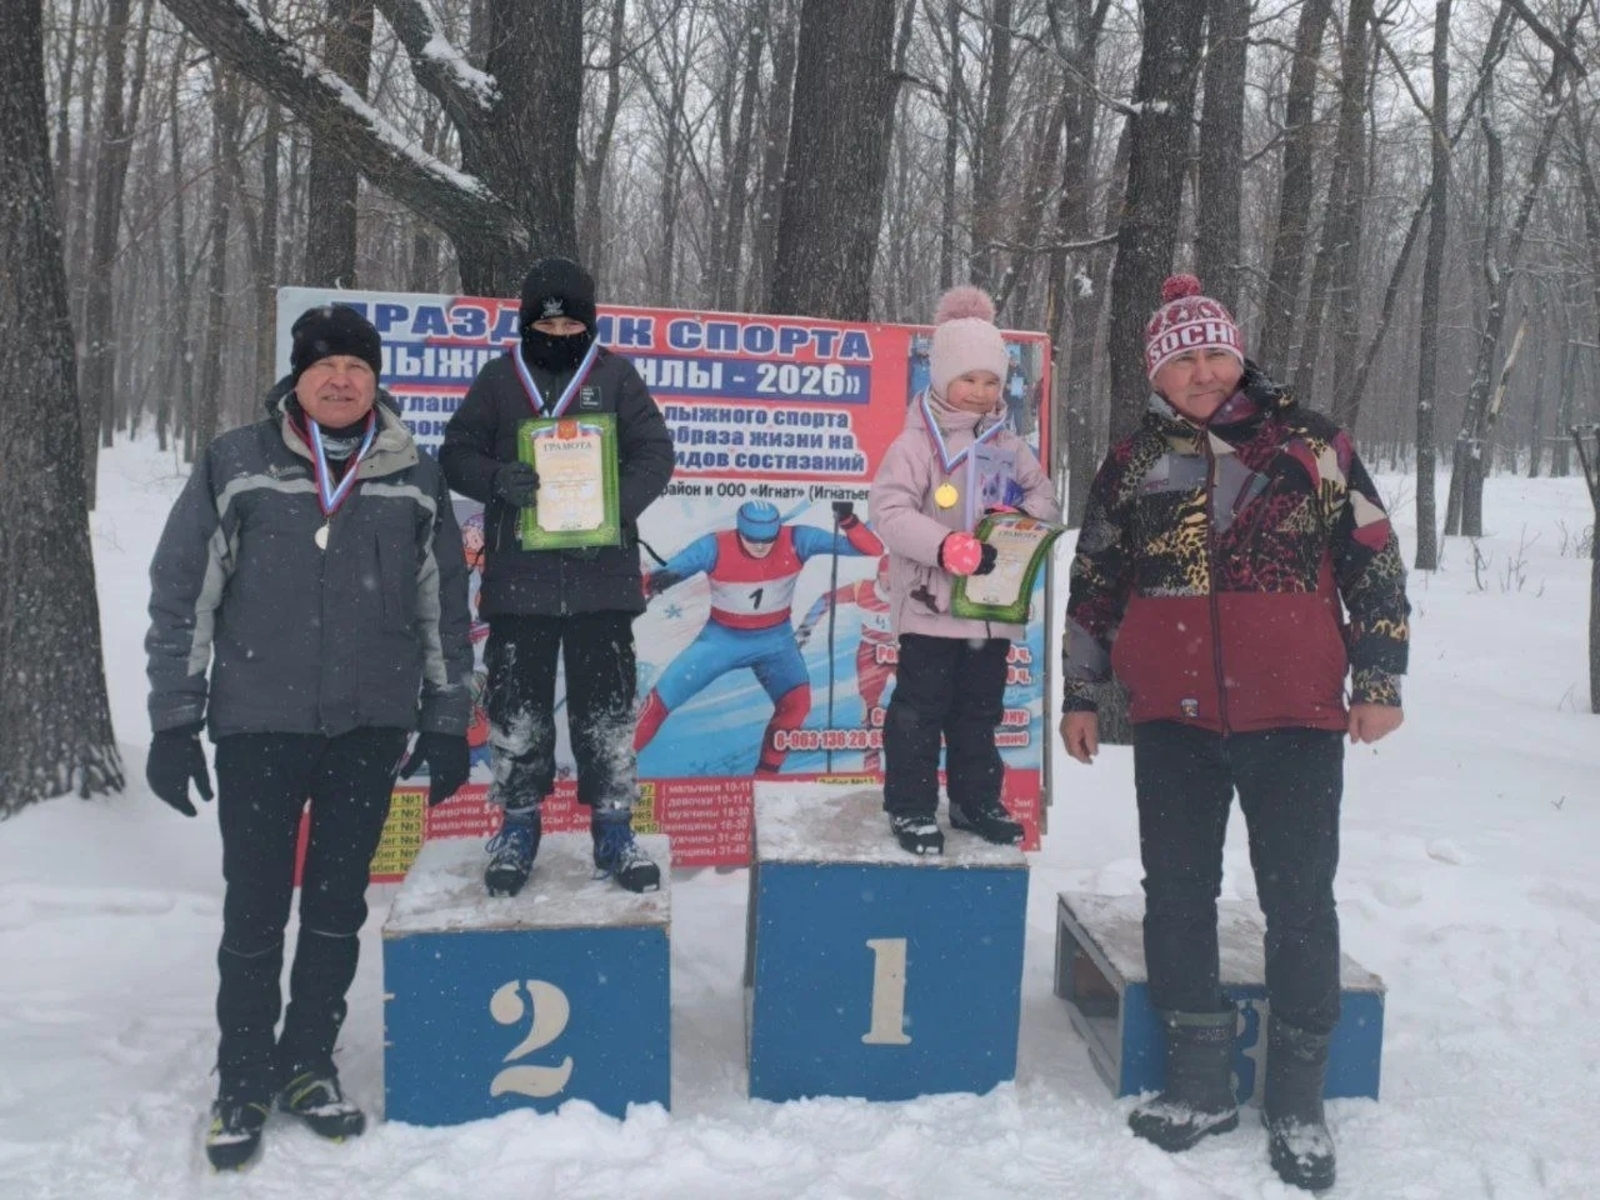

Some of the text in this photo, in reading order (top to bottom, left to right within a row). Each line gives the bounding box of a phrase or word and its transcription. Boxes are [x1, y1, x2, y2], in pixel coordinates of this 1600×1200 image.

[668, 320, 873, 361] СПОРТА
[1149, 323, 1236, 361] SOCHI
[756, 364, 860, 396] 2026»
[773, 411, 849, 429] спорта
[544, 442, 592, 452] ГРАМОТА
[750, 431, 822, 449] жизни
[828, 435, 854, 450] на
[674, 451, 865, 472] идов состязаний
[705, 485, 714, 496] и
[717, 483, 746, 497] ООО
[750, 484, 805, 499] «Игнат»
[749, 588, 764, 610] 1
[861, 938, 912, 1045] 1
[490, 980, 574, 1098] 2
